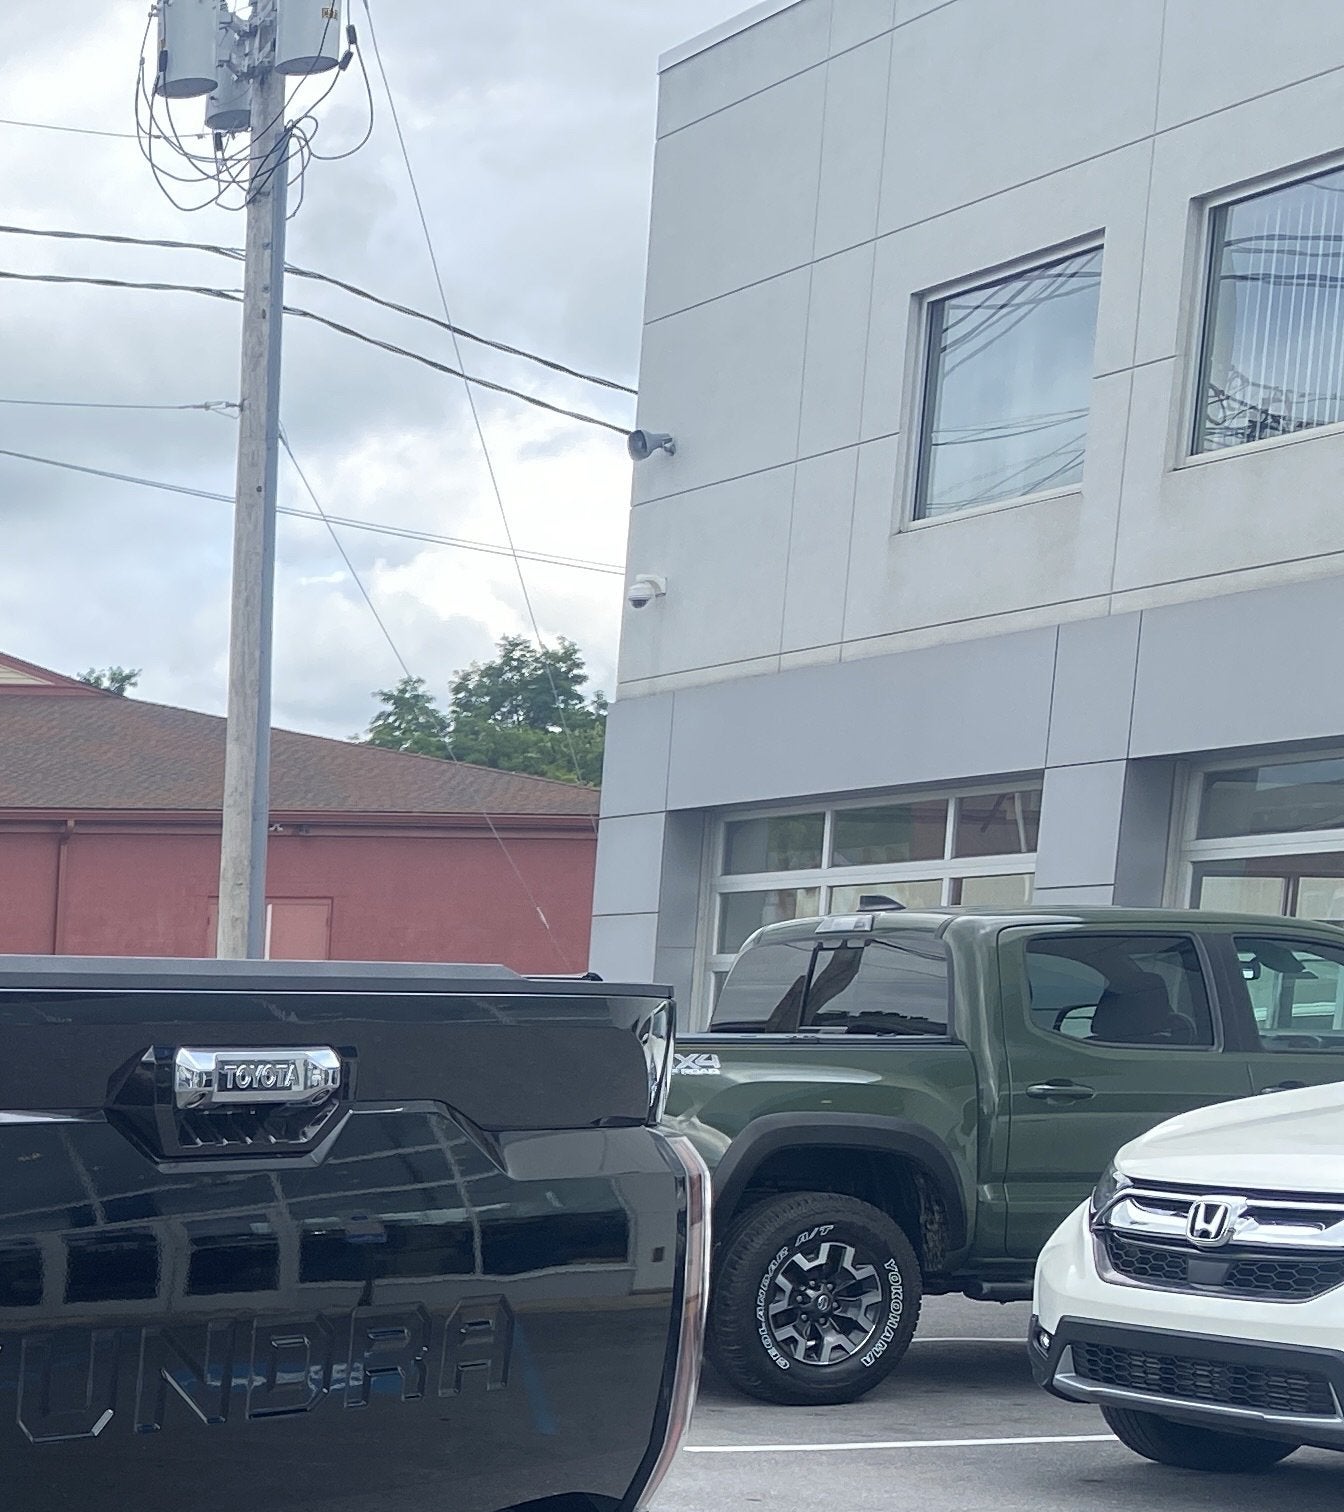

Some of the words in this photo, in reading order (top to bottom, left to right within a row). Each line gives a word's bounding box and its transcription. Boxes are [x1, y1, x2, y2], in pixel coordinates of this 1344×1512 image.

[672, 1053, 721, 1069] X4
[223, 1063, 300, 1089] TOYOTA
[860, 1258, 904, 1367] YOKOHAMA
